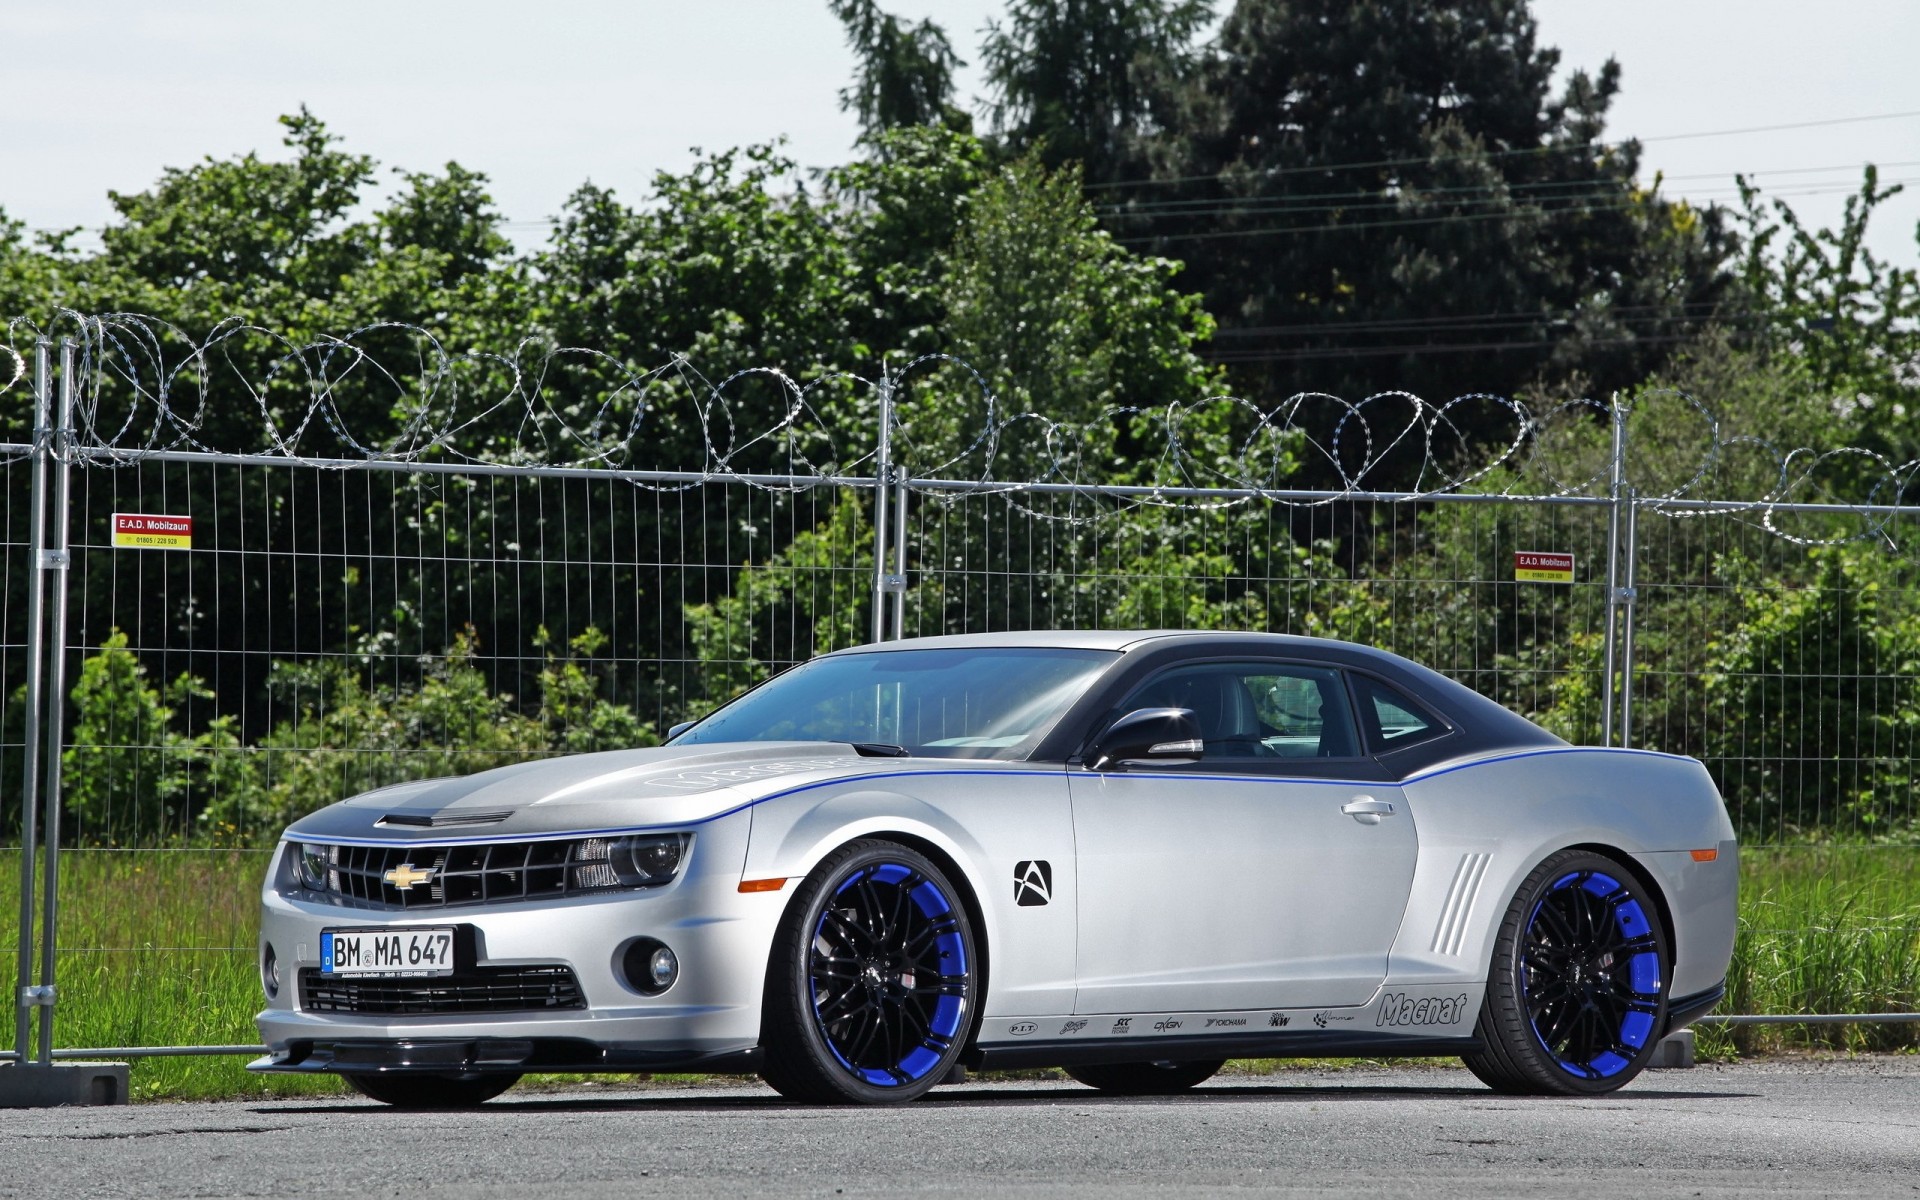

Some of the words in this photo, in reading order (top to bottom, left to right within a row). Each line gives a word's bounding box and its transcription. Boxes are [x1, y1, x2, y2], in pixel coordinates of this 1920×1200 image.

[119, 519, 145, 529] E.A.D.
[147, 520, 188, 531] Mobilzaun
[334, 937, 360, 967] BM
[374, 936, 402, 966] MA
[408, 934, 450, 965] 647
[325, 956, 331, 966] D
[1376, 992, 1468, 1028] Magnat
[1214, 1018, 1247, 1027] YOKOHAMA
[1270, 1016, 1290, 1026] KW
